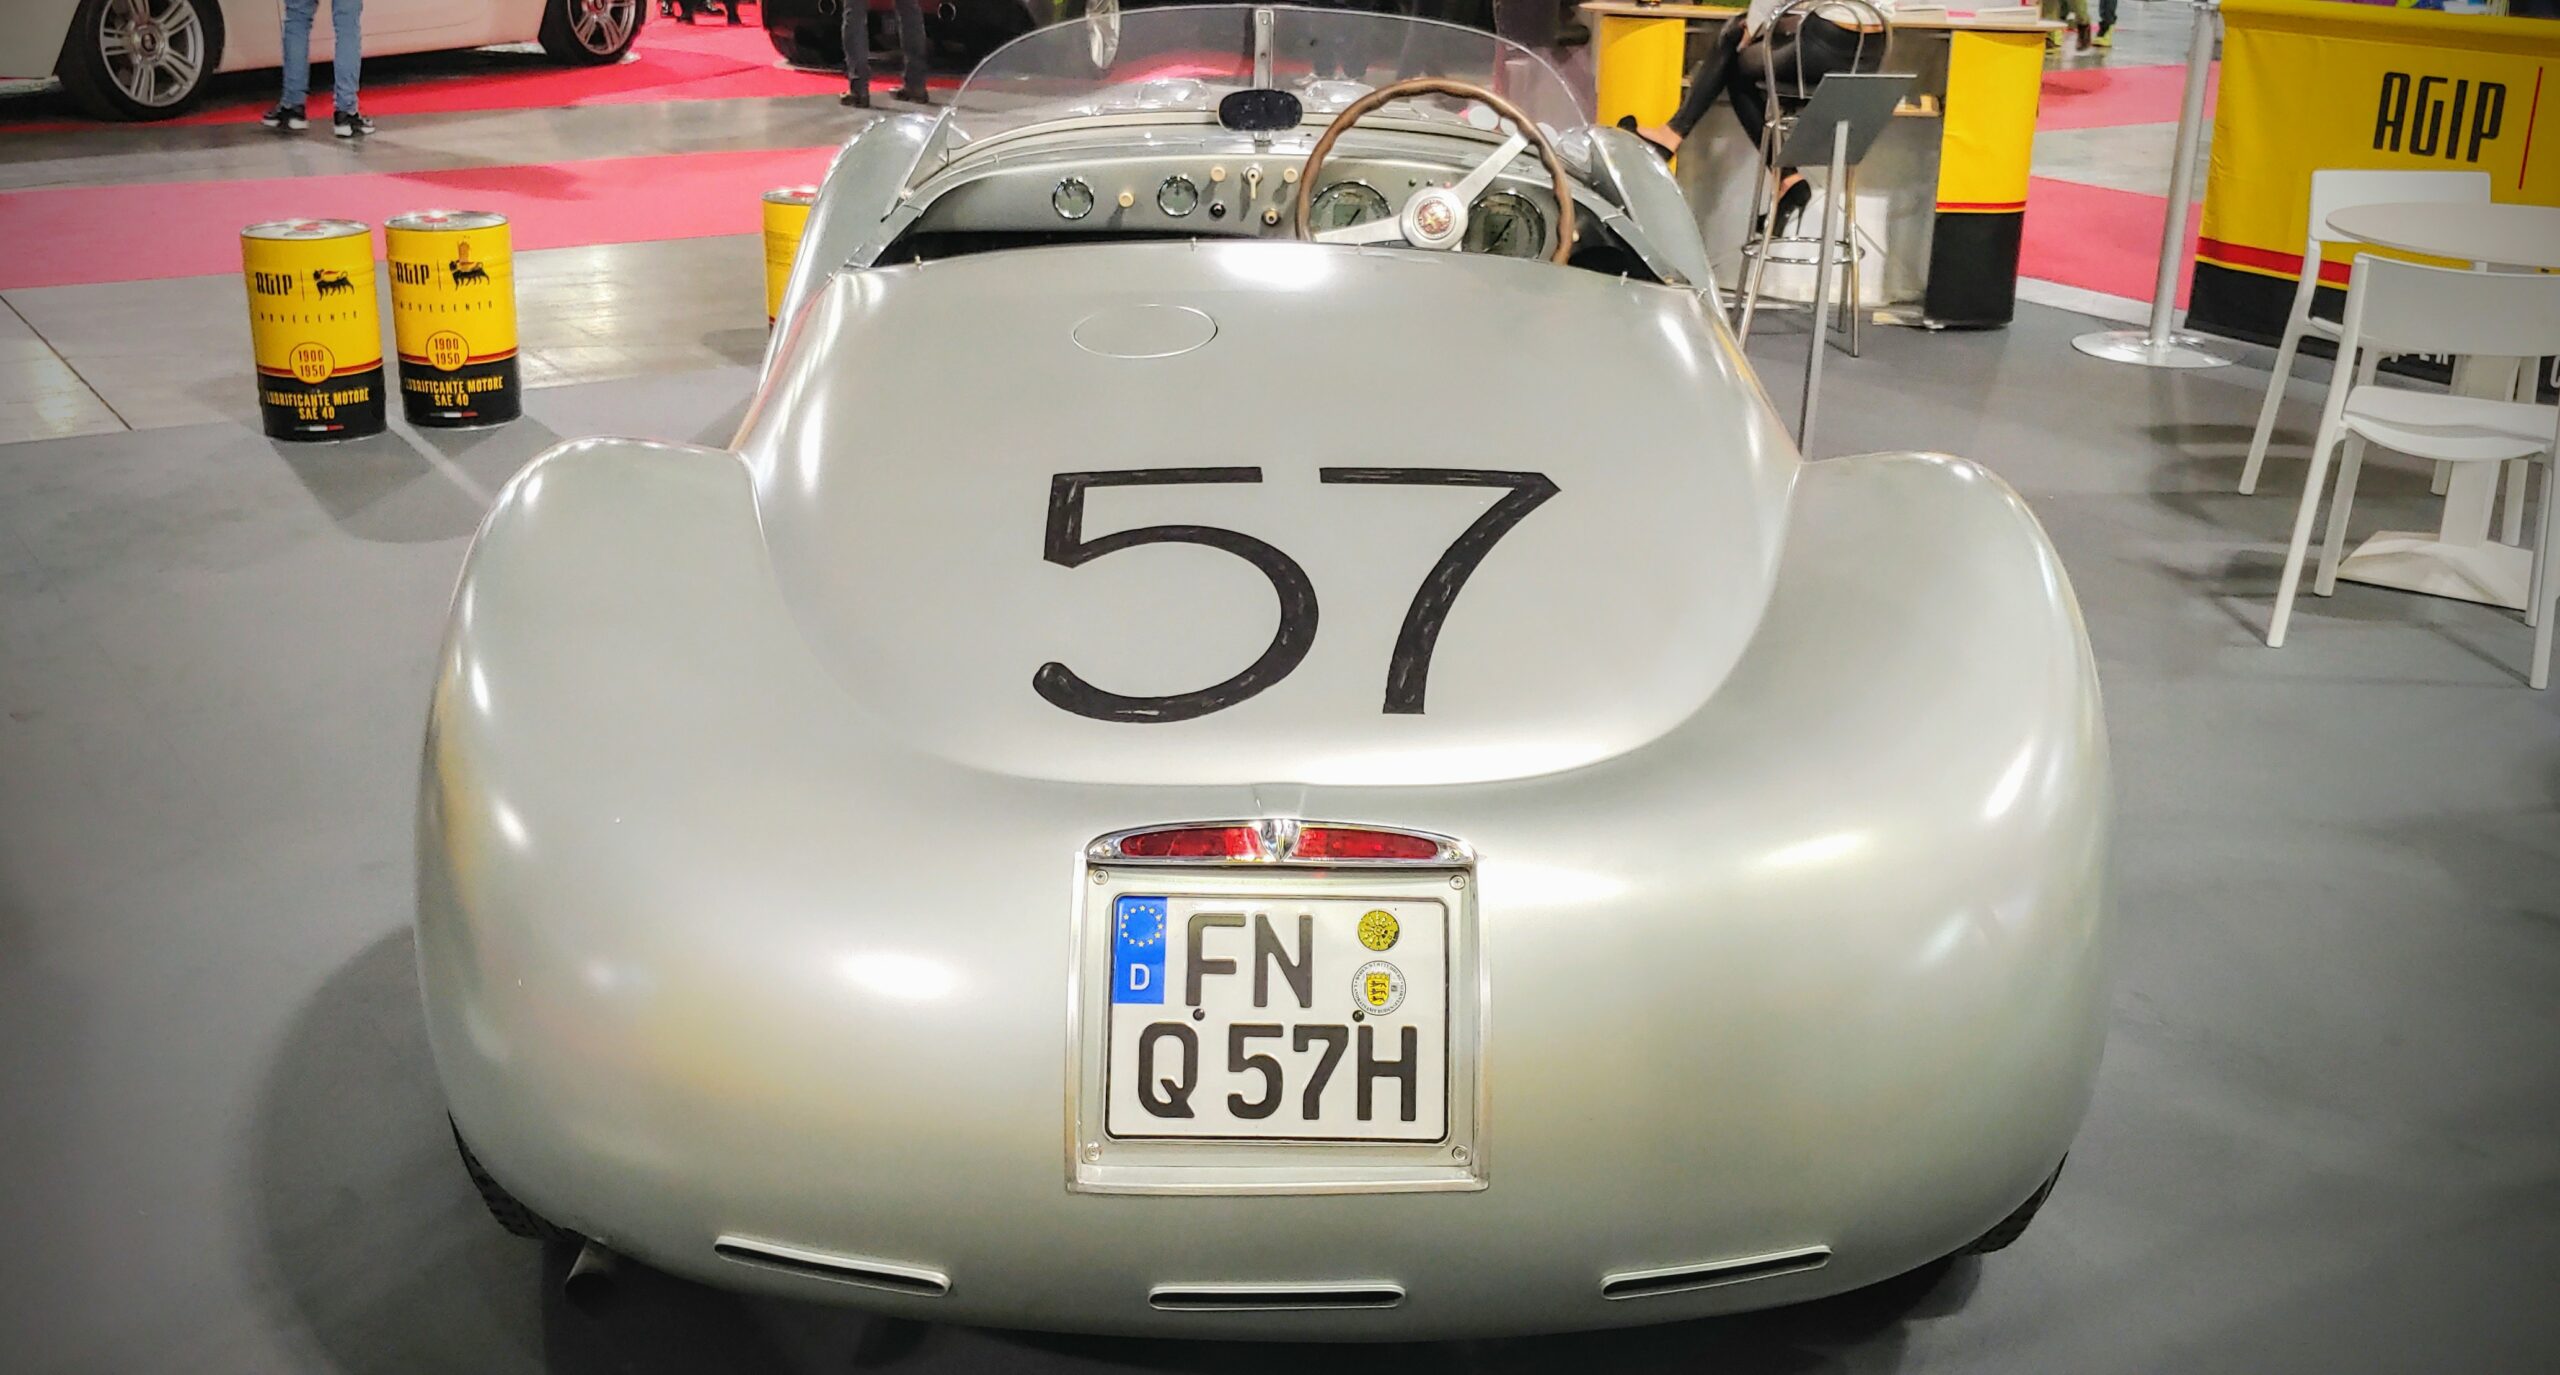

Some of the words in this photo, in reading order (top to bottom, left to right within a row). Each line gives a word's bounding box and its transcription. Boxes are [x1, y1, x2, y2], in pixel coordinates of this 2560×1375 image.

[2373, 71, 2507, 163] AGIP
[396, 261, 430, 285] AGIP
[255, 271, 293, 296] AGIP
[434, 338, 459, 350] 1900
[298, 350, 324, 362] 1900
[435, 353, 460, 365] 1950
[299, 364, 326, 377] 1950
[467, 376, 504, 393] MOTORE
[333, 387, 369, 406] MOTORE
[434, 394, 454, 407] SAE
[456, 393, 469, 406] 40
[299, 407, 319, 420] SAE
[322, 406, 335, 419] 40
[1032, 466, 1562, 724] 57
[1185, 913, 1313, 1008] FN
[1129, 963, 1151, 990] D
[1137, 1022, 1198, 1119] Q
[1227, 1023, 1417, 1122] 57H
